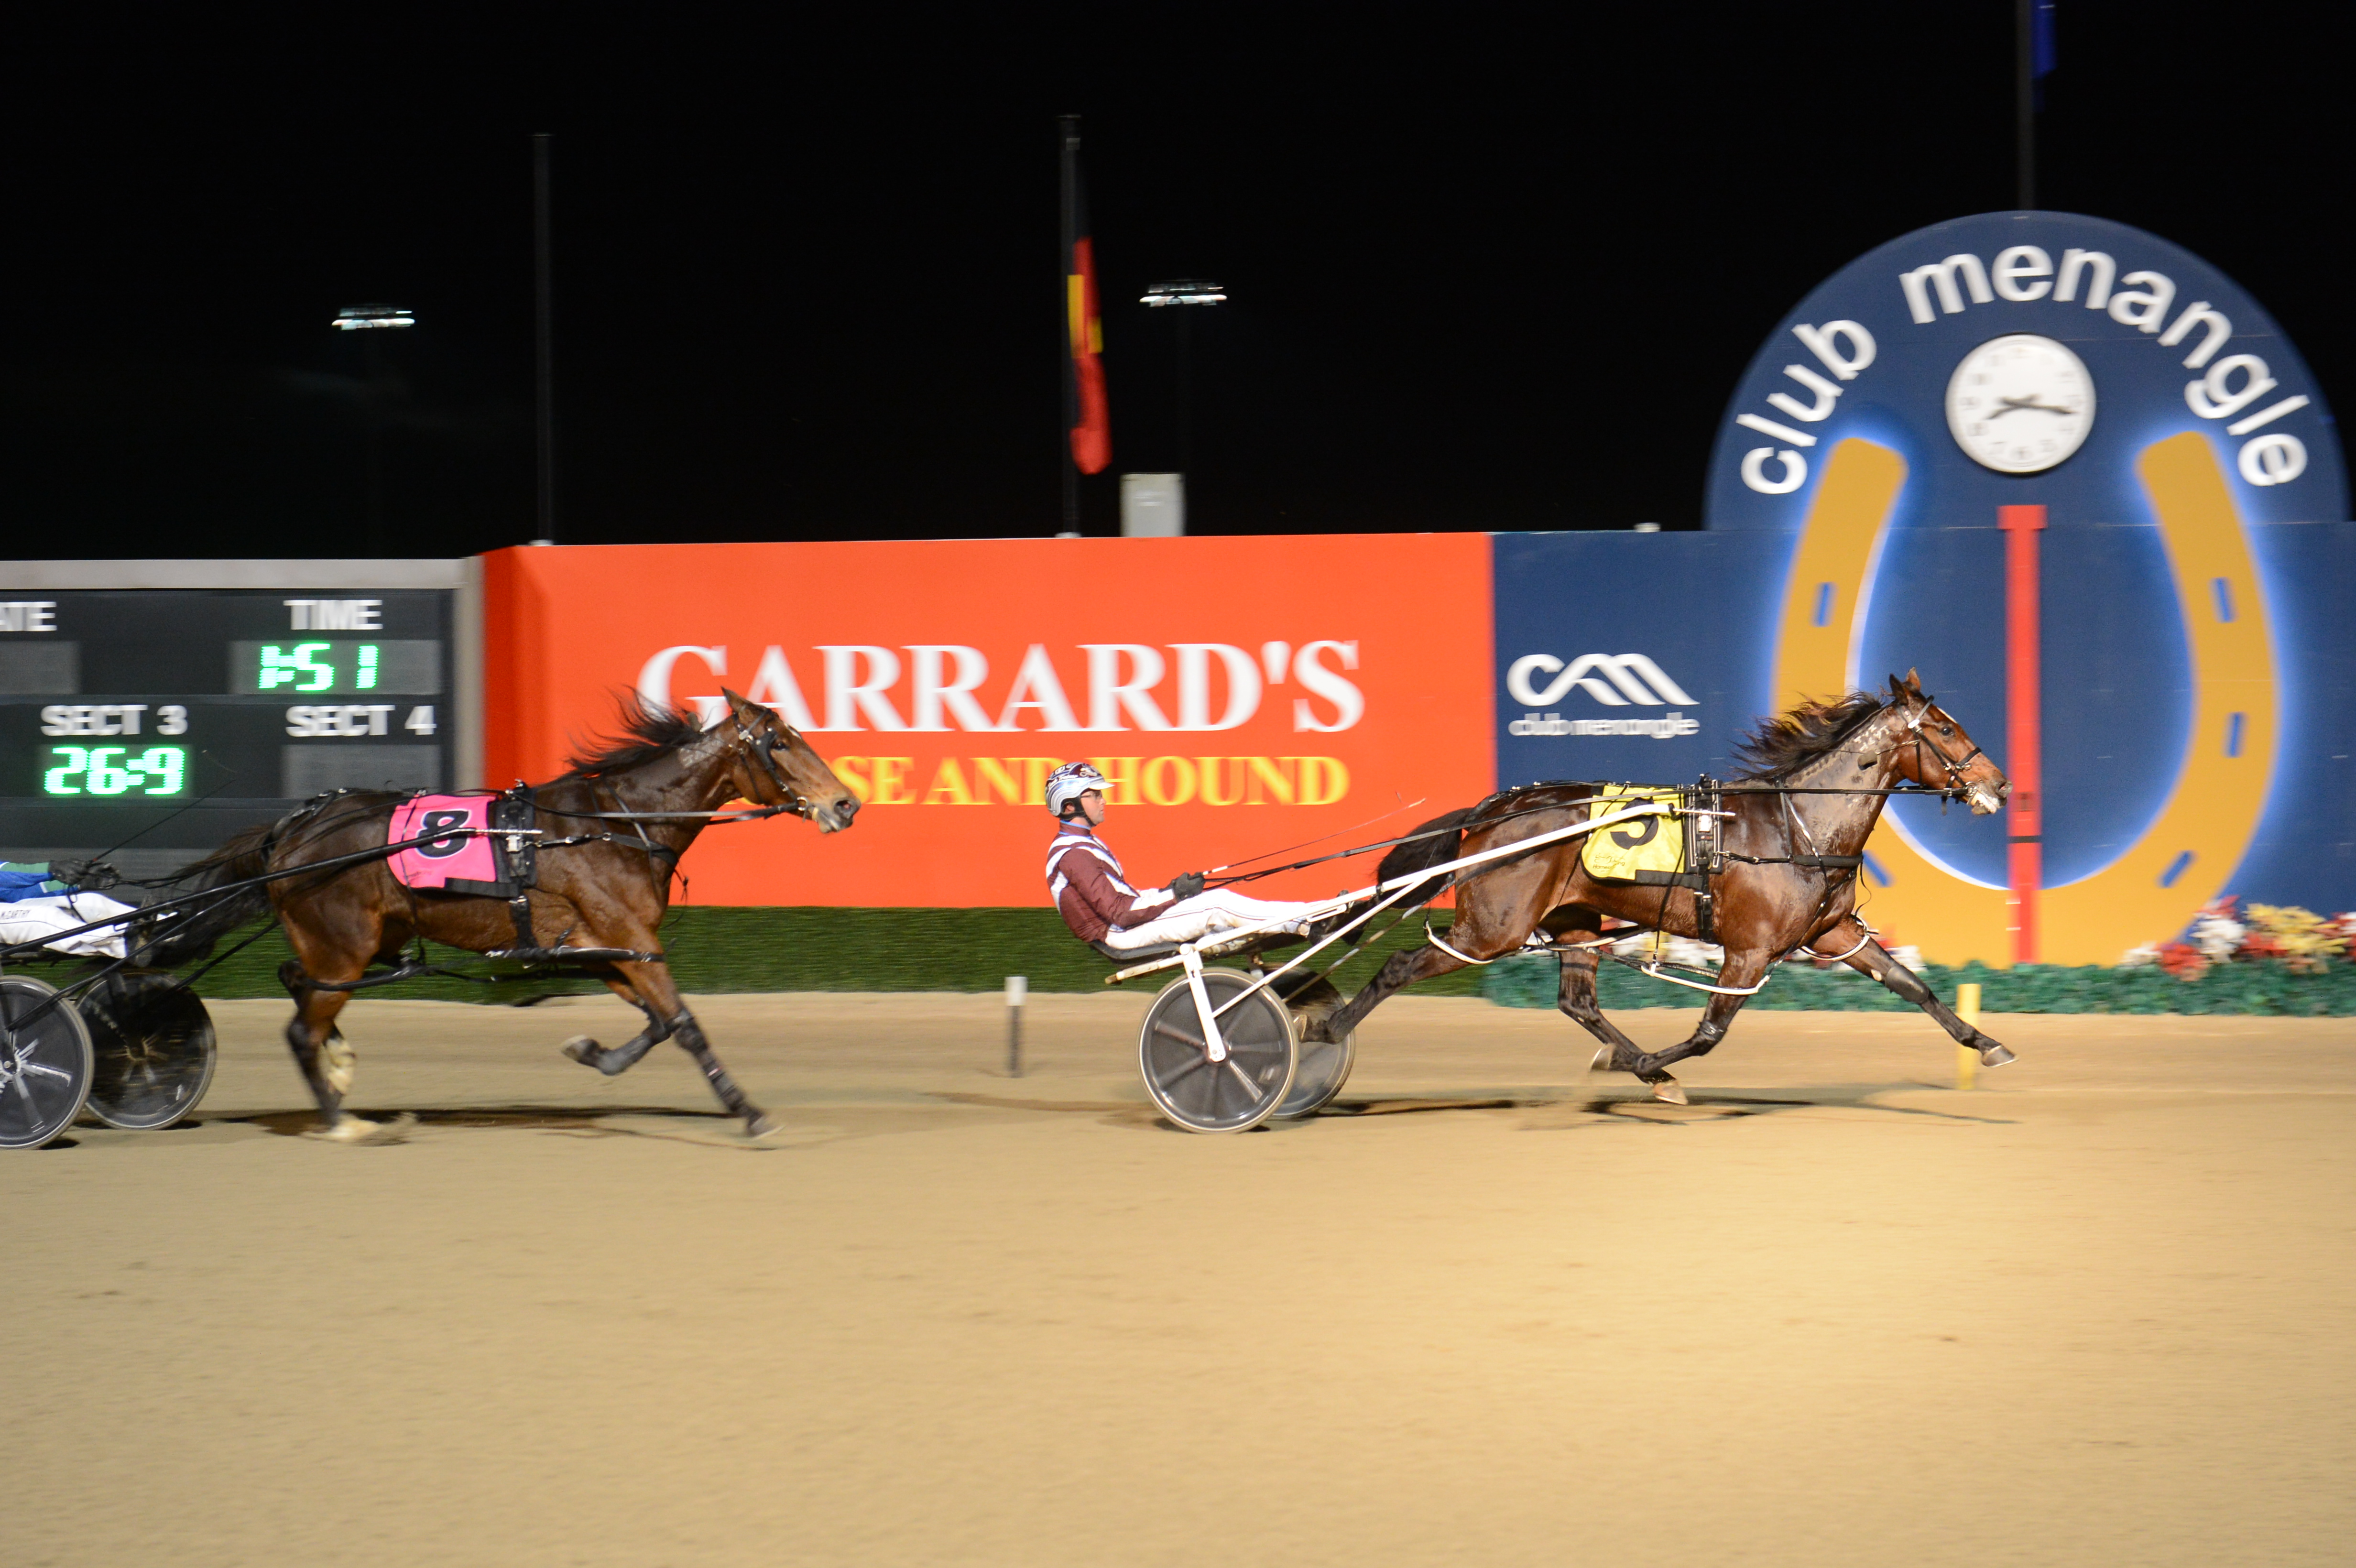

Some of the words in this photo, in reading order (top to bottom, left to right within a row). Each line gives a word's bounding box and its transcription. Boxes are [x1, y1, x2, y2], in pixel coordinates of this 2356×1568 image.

[1735, 319, 1877, 495] club
[1899, 245, 2310, 487] menangle
[284, 599, 383, 630] TIME
[636, 640, 1365, 732] GARRARD'S
[40, 705, 148, 736] SECT
[157, 705, 187, 735] 3
[286, 705, 395, 736] SECT
[405, 706, 436, 735] 4
[920, 756, 1070, 806] AND
[1084, 756, 1351, 806] HOUND
[415, 808, 472, 860] 8
